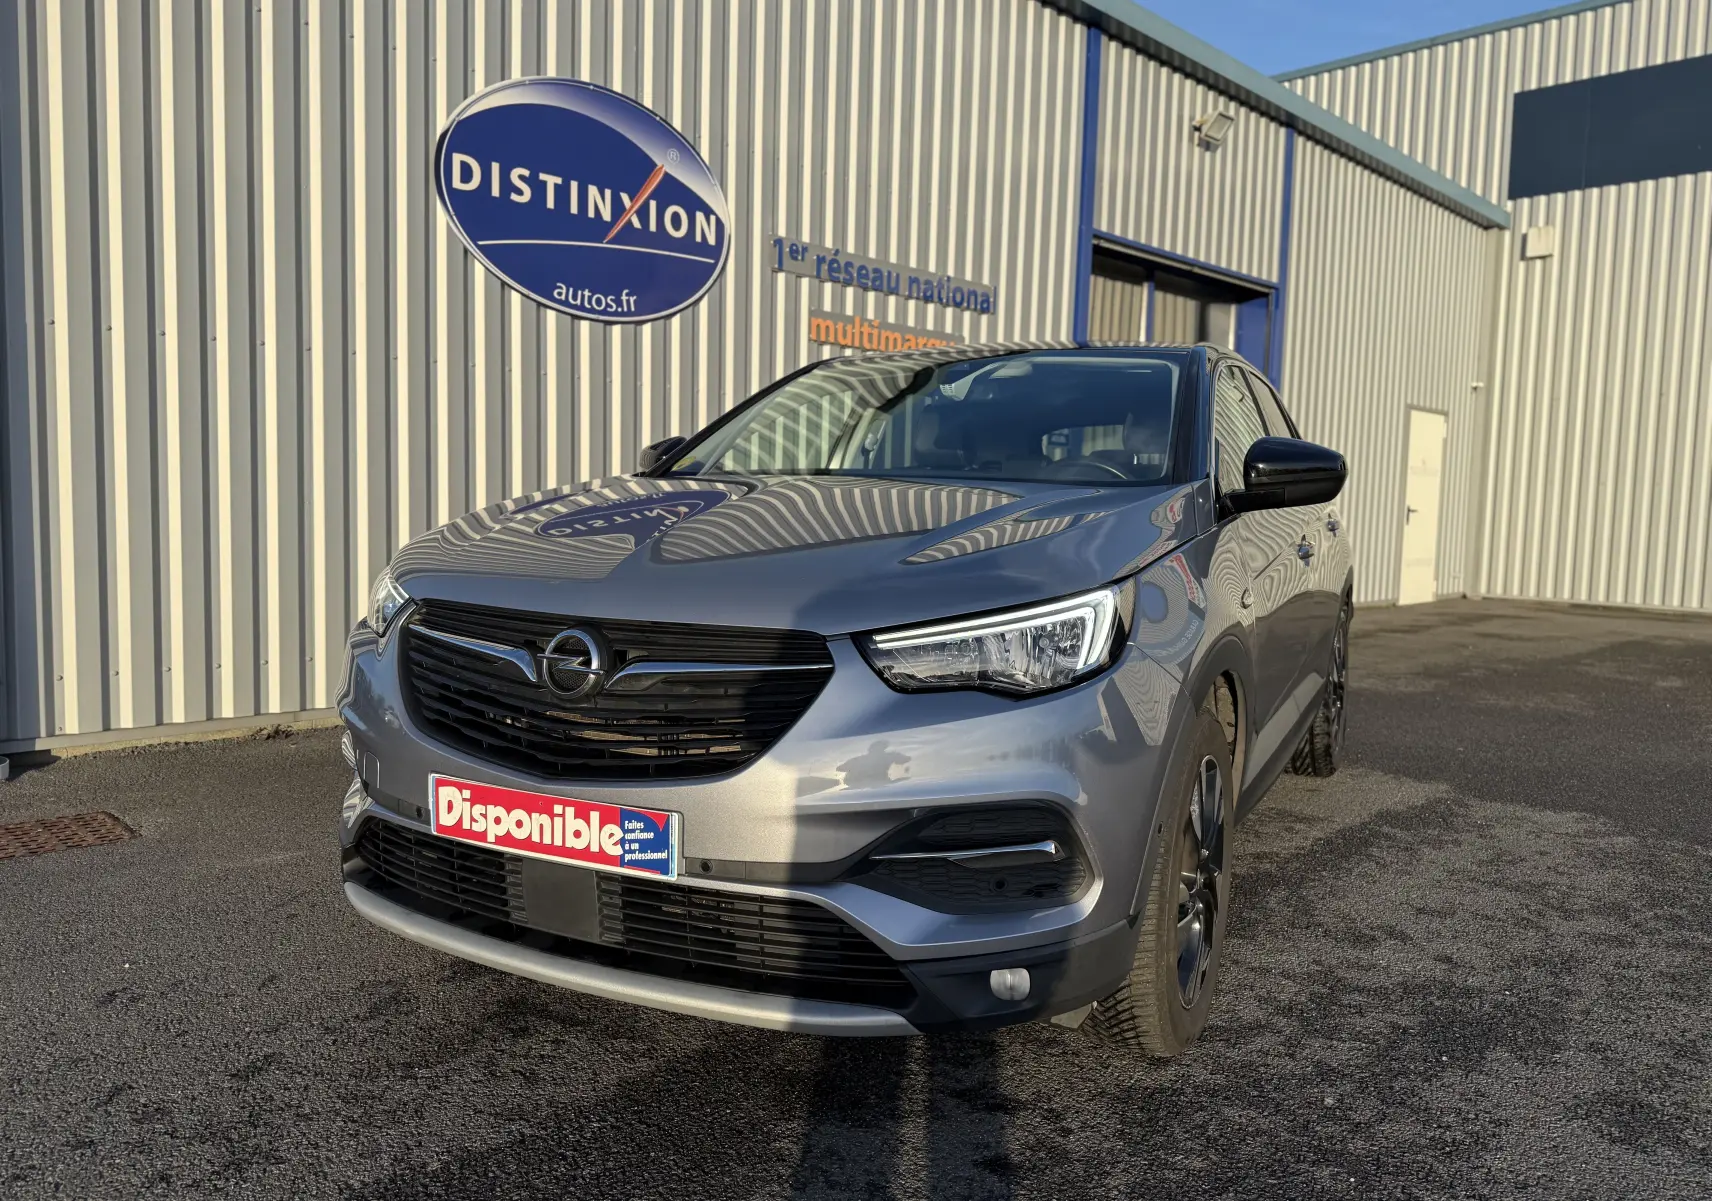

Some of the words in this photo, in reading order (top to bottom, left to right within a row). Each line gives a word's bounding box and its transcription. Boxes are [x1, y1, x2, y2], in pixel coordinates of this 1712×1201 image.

[451, 152, 717, 246] DISTINXION
[773, 238, 808, 271] 1er
[815, 249, 901, 295] réseau
[907, 275, 997, 315] national
[553, 283, 637, 312] autos.fr
[810, 315, 955, 352] multimar
[438, 786, 624, 856] Disponible
[624, 820, 645, 829] Faites
[624, 830, 655, 839] confiance
[624, 841, 630, 850] à
[630, 842, 640, 850] un
[624, 849, 668, 862] professionnel
